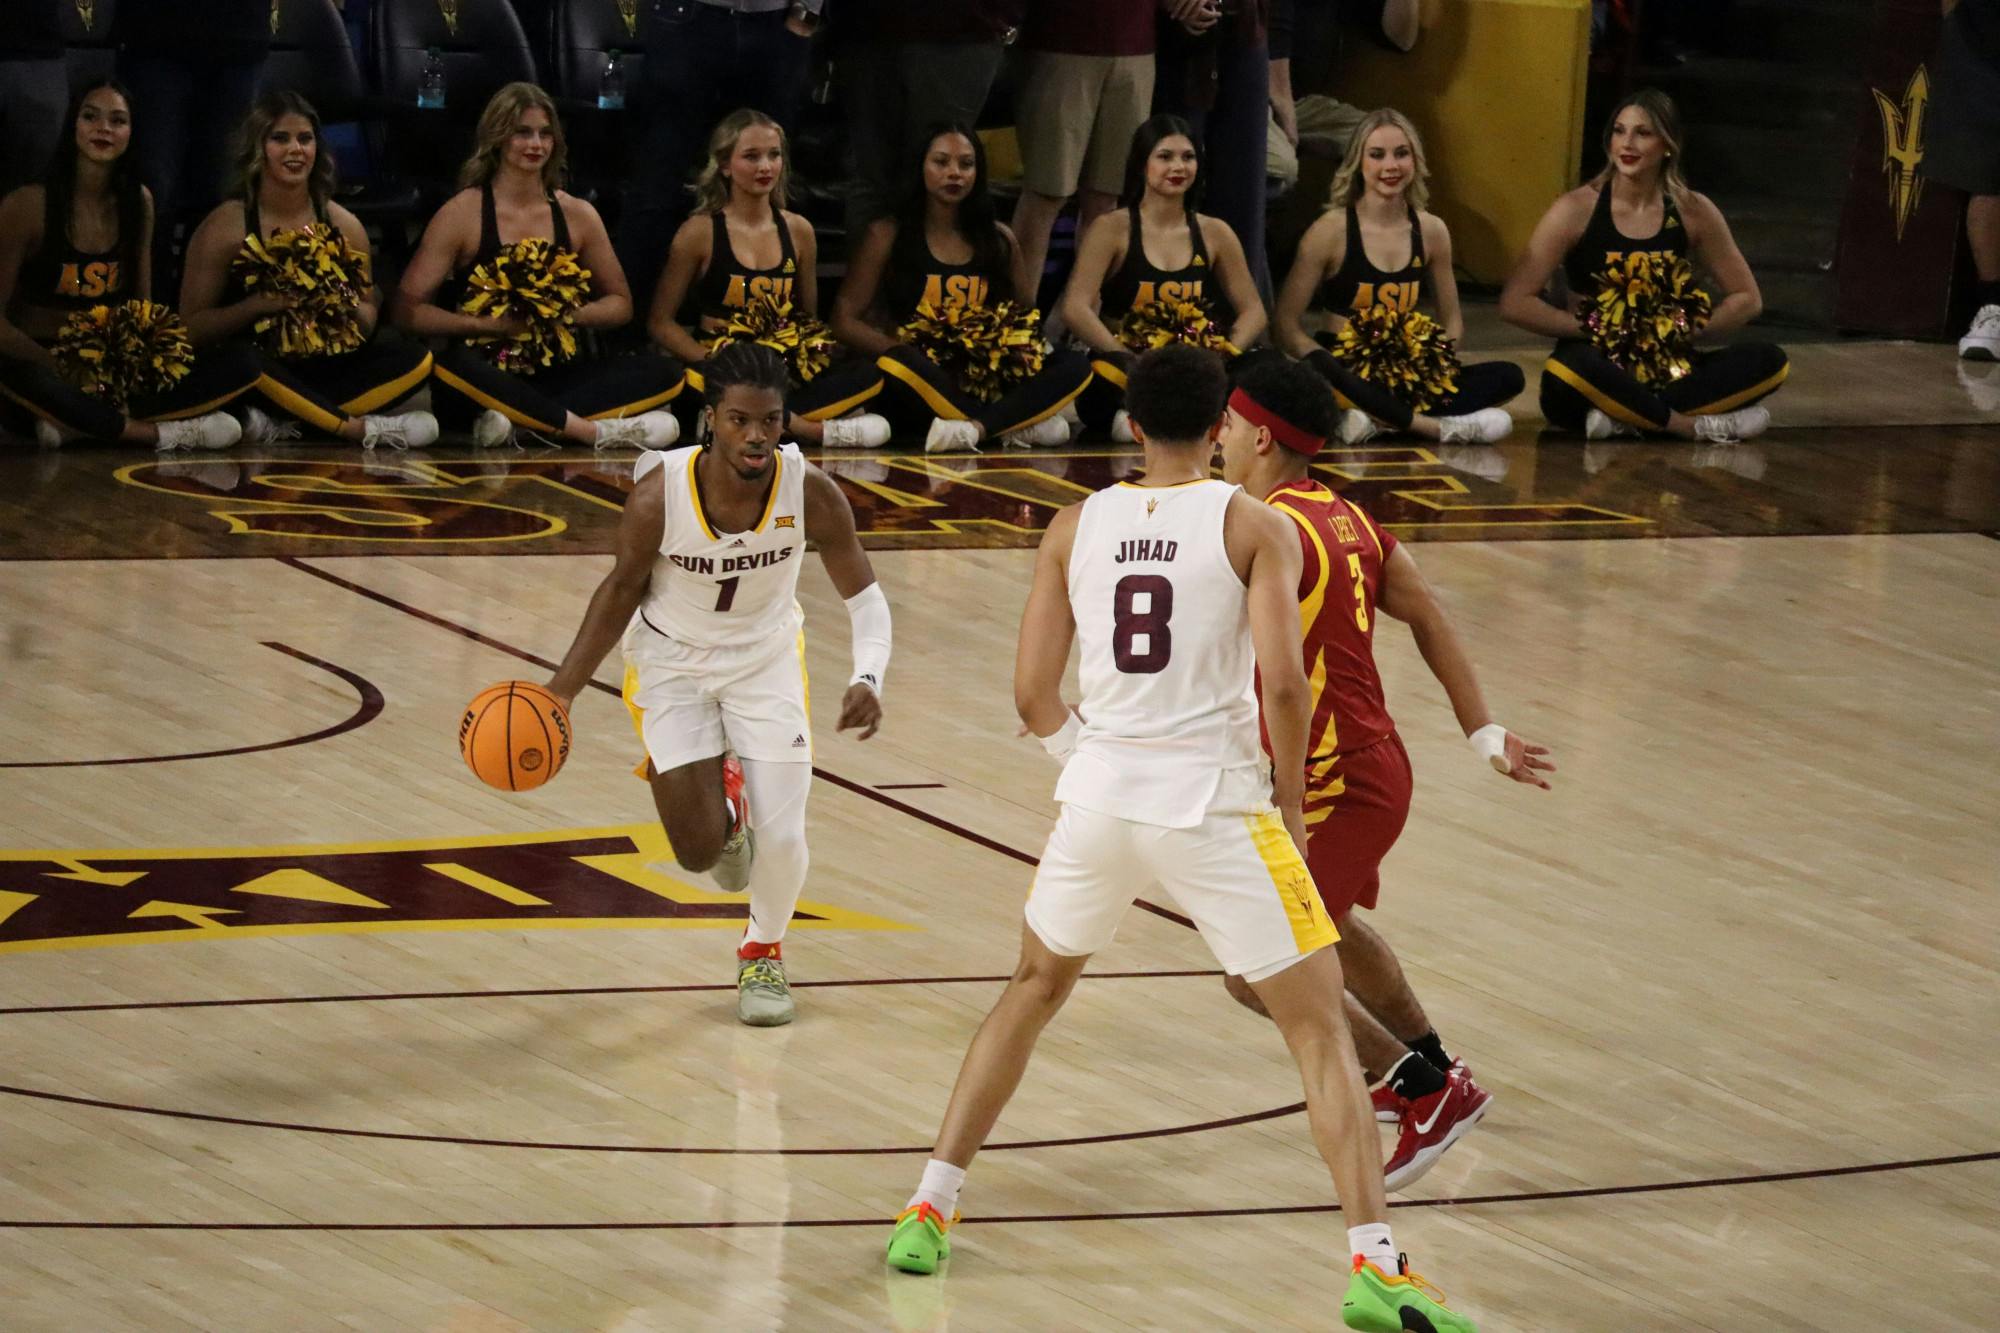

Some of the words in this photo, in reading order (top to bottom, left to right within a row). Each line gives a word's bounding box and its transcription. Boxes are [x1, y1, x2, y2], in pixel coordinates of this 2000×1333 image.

[919, 273, 988, 309] ASU
[1351, 280, 1420, 312] ASU
[669, 554, 714, 575] SUN
[722, 546, 793, 573] DEVILS
[1115, 539, 1179, 564] JIHAD
[714, 575, 740, 612] 1
[1347, 553, 1369, 633] 3
[1113, 574, 1174, 674] 8
